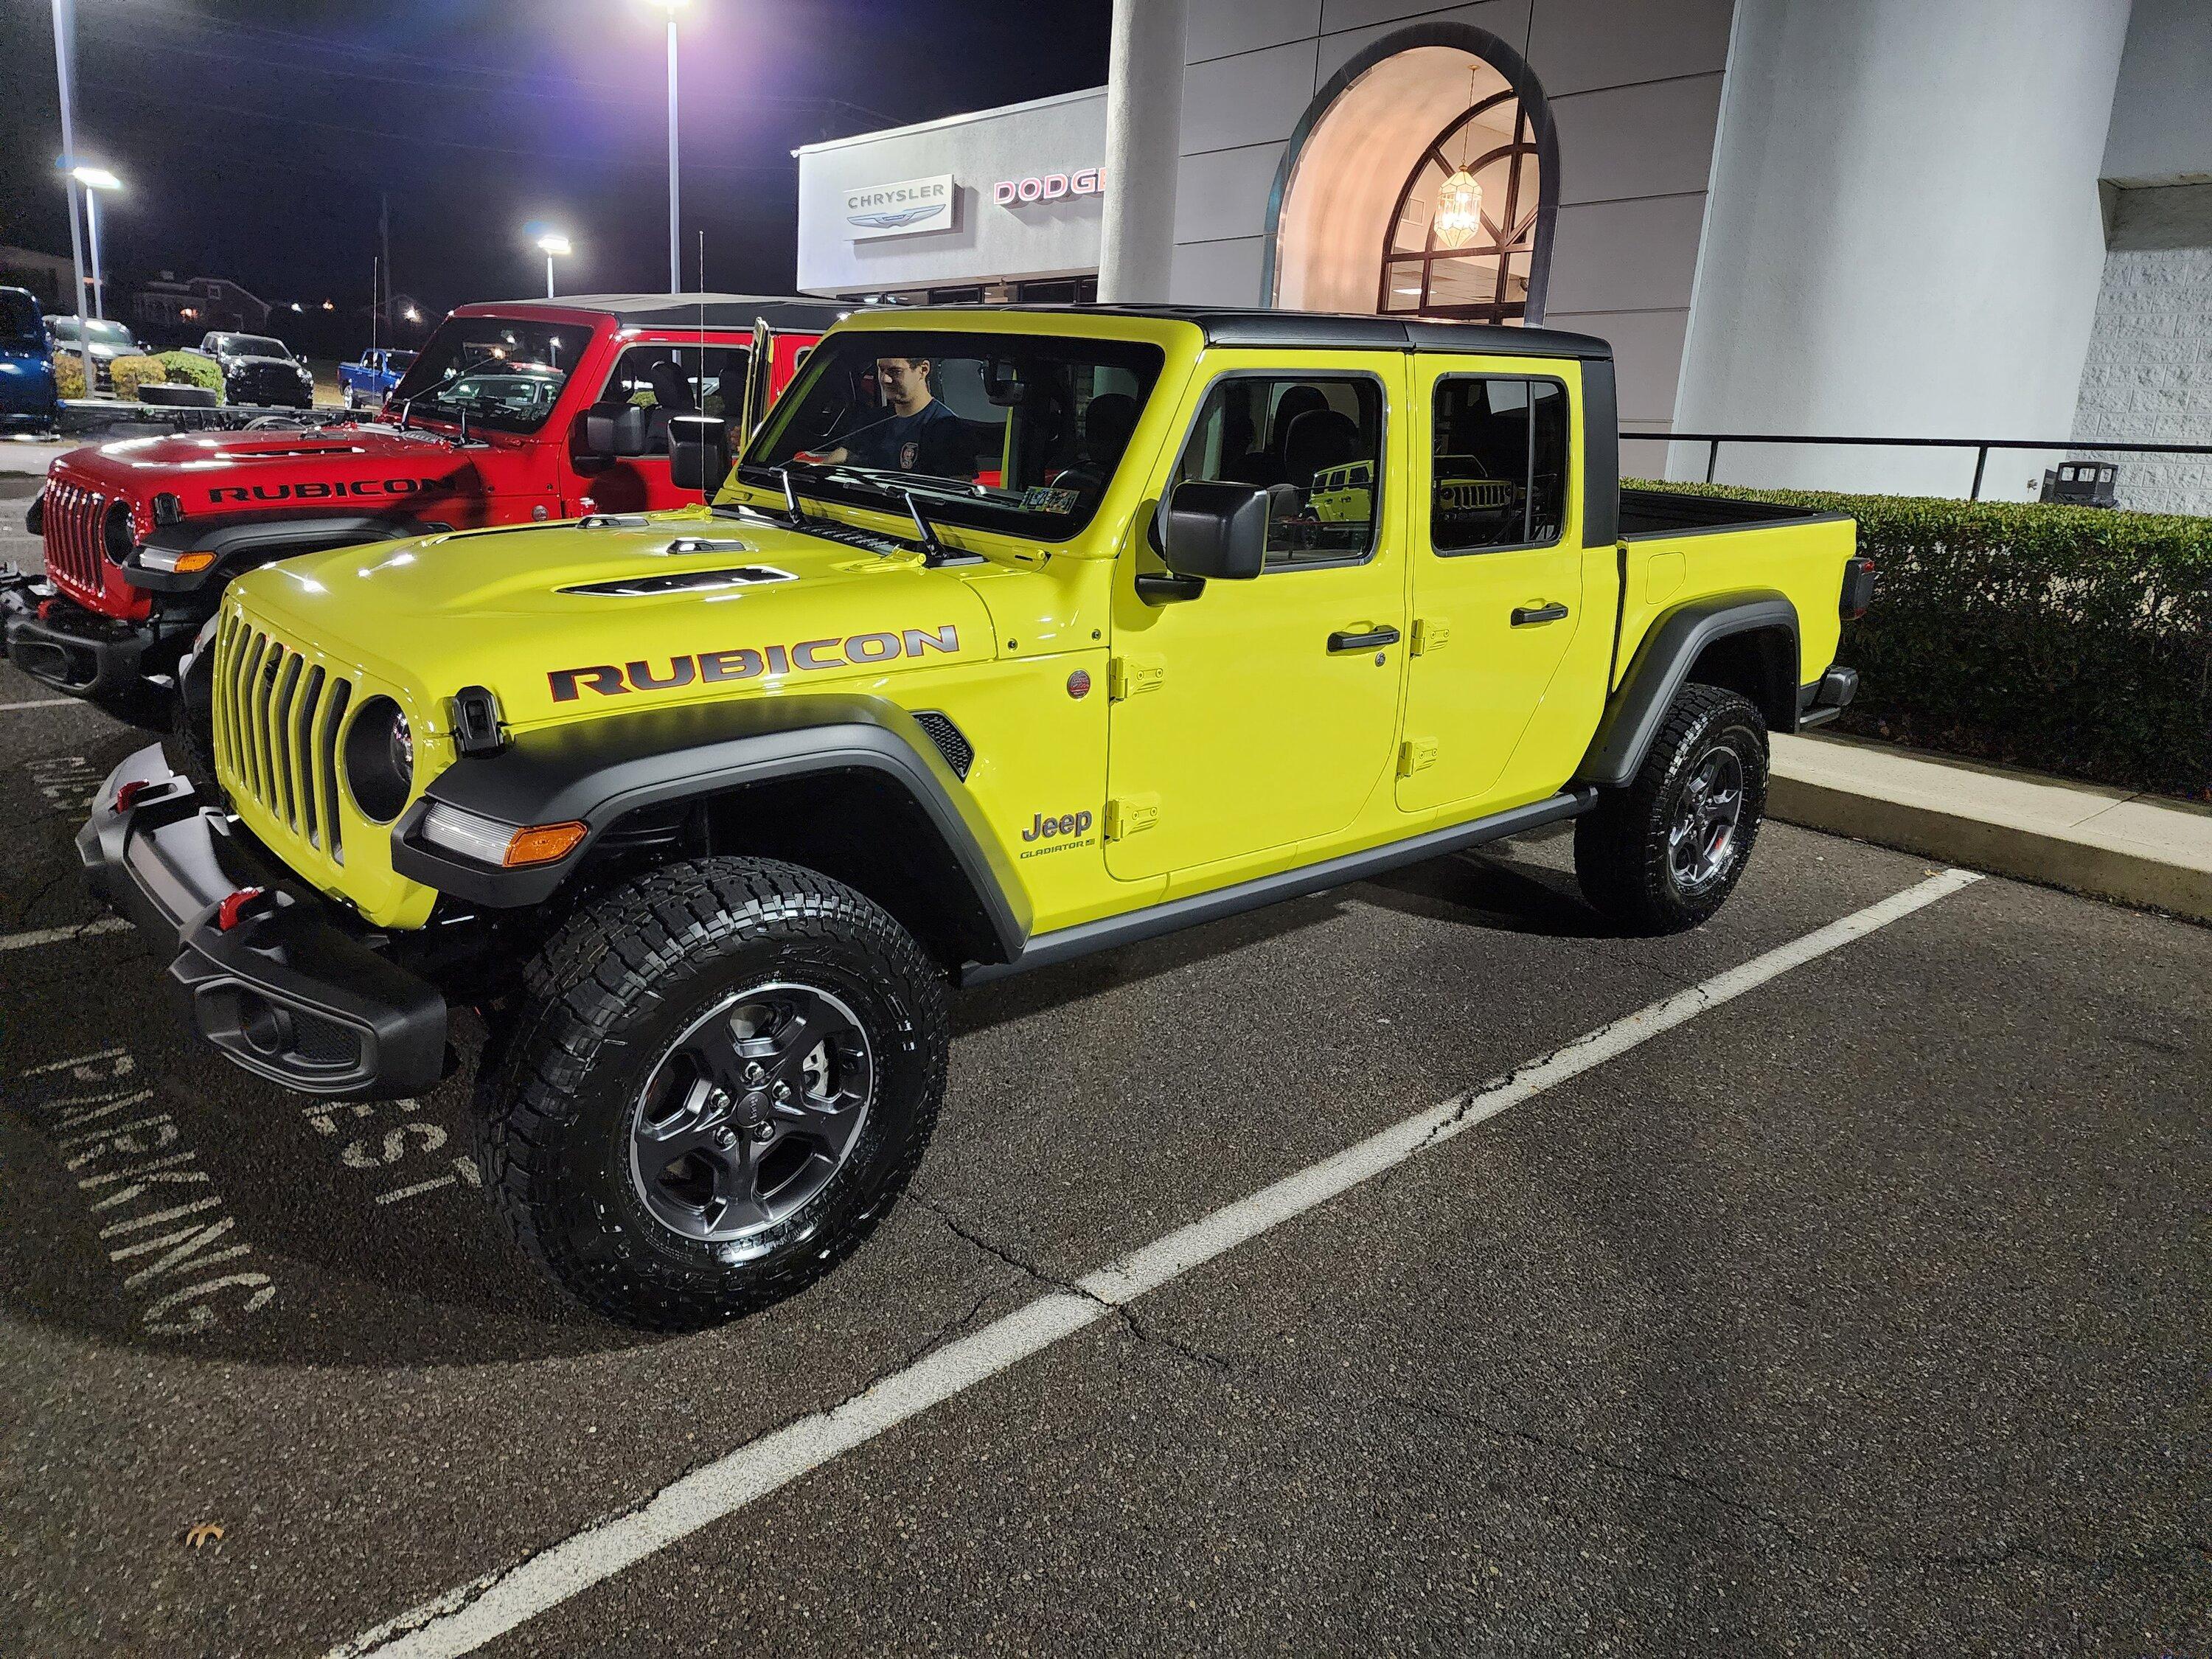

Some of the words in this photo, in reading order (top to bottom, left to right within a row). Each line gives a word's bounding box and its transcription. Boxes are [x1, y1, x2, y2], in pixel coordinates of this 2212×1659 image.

[848, 184, 945, 209] CHRYSLER
[208, 477, 458, 504] RUBICON
[546, 625, 961, 703] RUBICON
[1022, 810, 1093, 842] Jeep
[1020, 841, 1084, 860] GLADIATOR
[21, 1047, 276, 1333] PARKING
